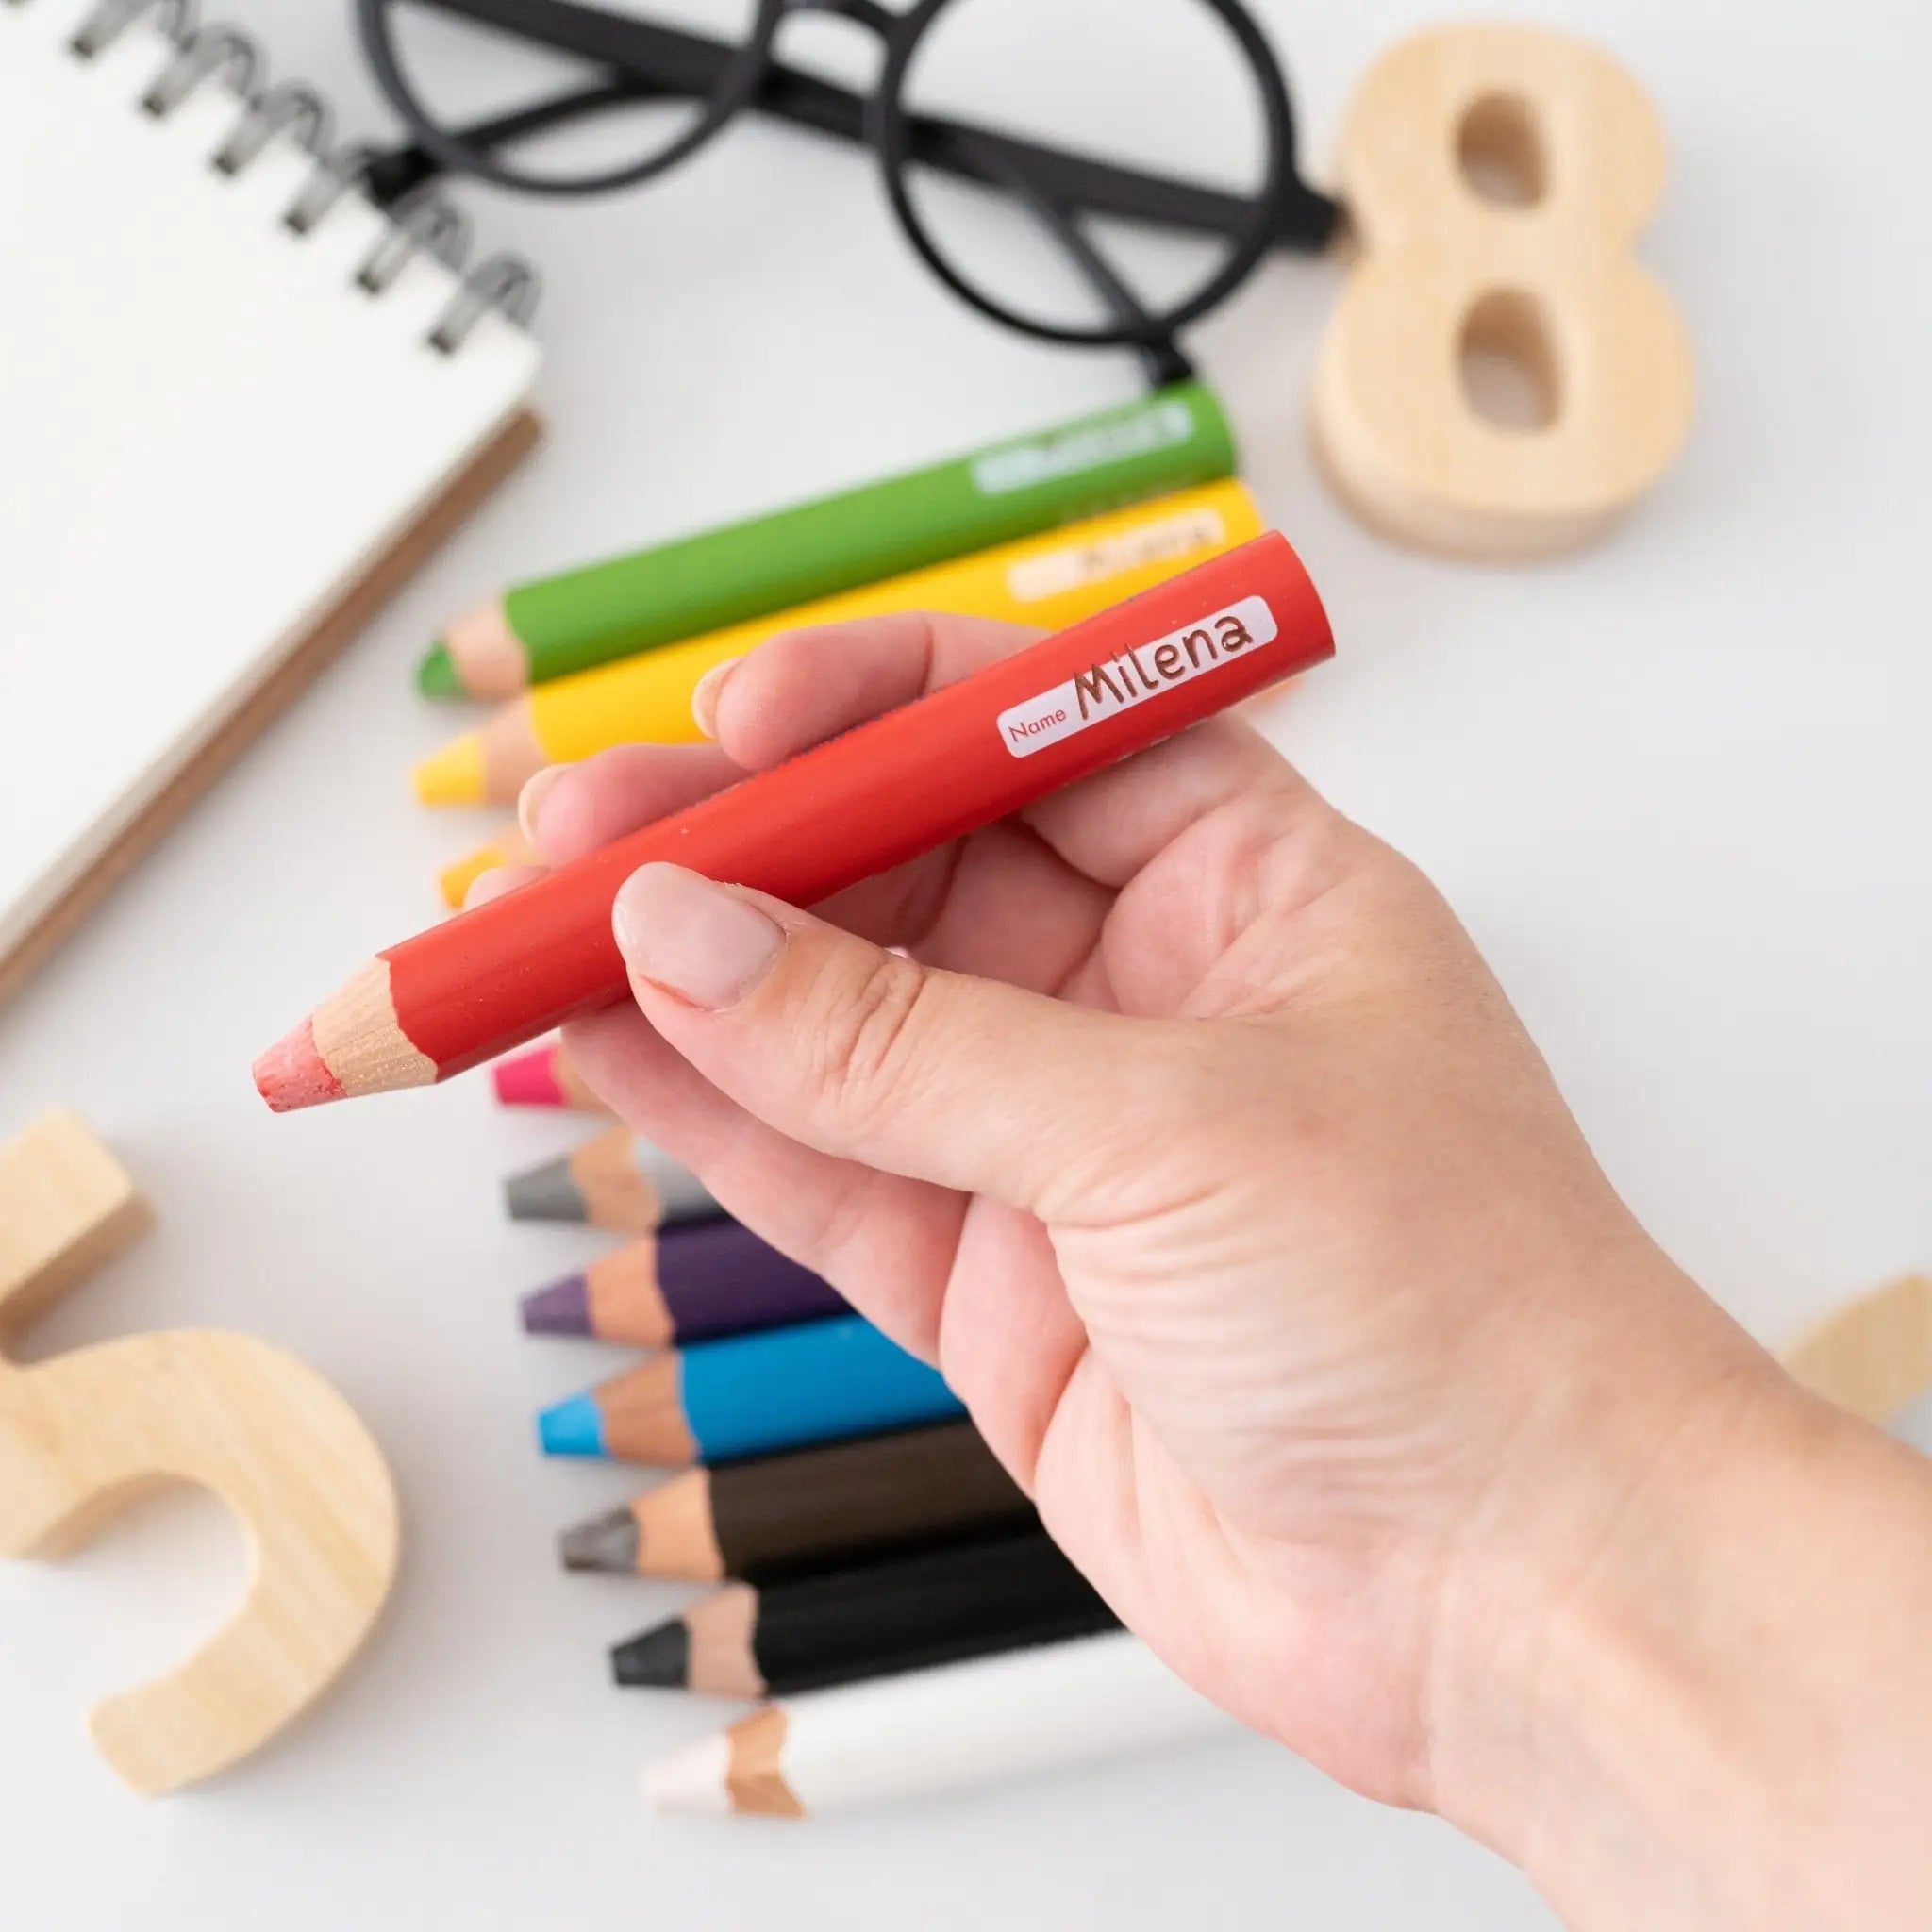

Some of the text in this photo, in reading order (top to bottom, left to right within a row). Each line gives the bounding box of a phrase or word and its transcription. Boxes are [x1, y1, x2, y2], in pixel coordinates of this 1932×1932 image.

[1313, 23, 1697, 557] 8
[1008, 615, 1255, 743] Name Milena
[0, 1106, 401, 1796] 5
